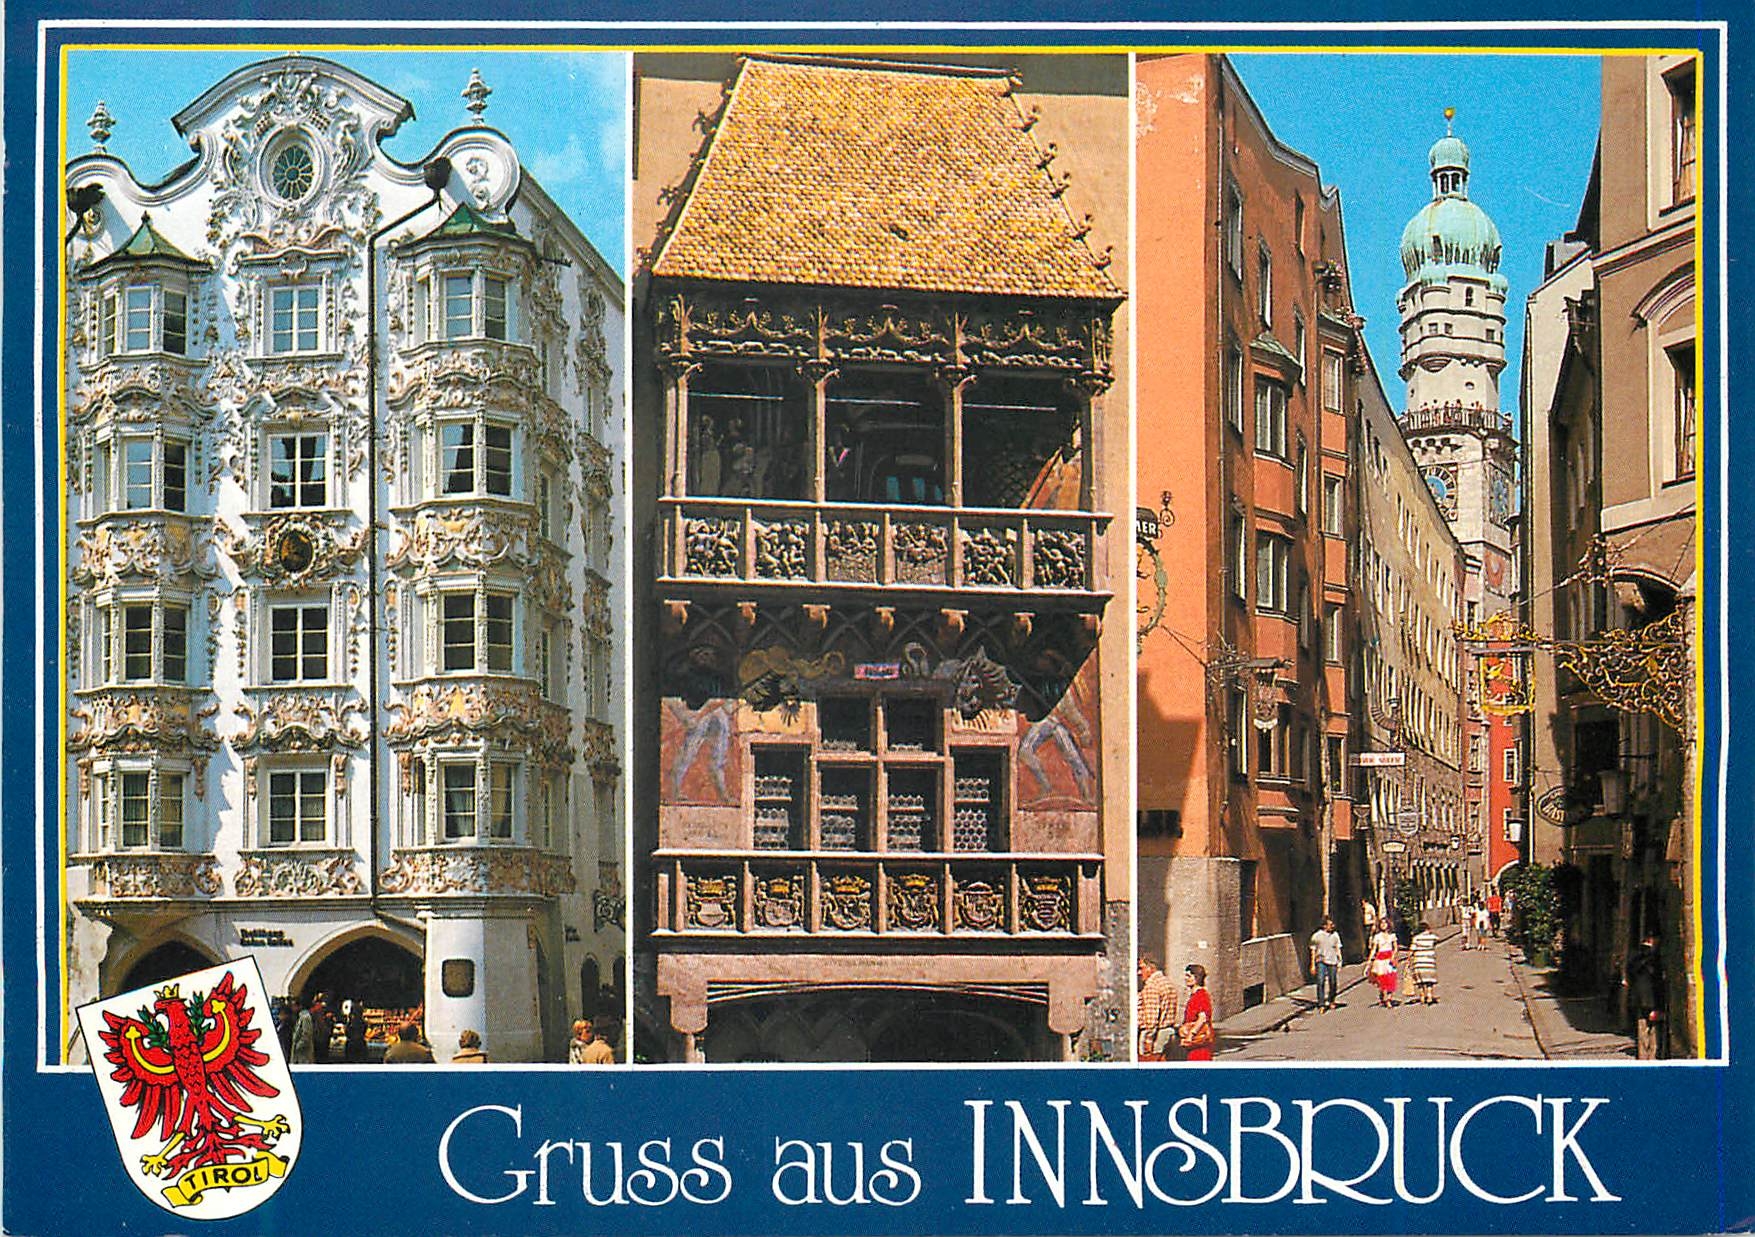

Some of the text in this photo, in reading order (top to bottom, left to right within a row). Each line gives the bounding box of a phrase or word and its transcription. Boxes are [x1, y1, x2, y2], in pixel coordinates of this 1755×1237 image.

[184, 1166, 262, 1190] TIROL
[438, 1093, 1623, 1209] Gruss aus INNSBRUCK
